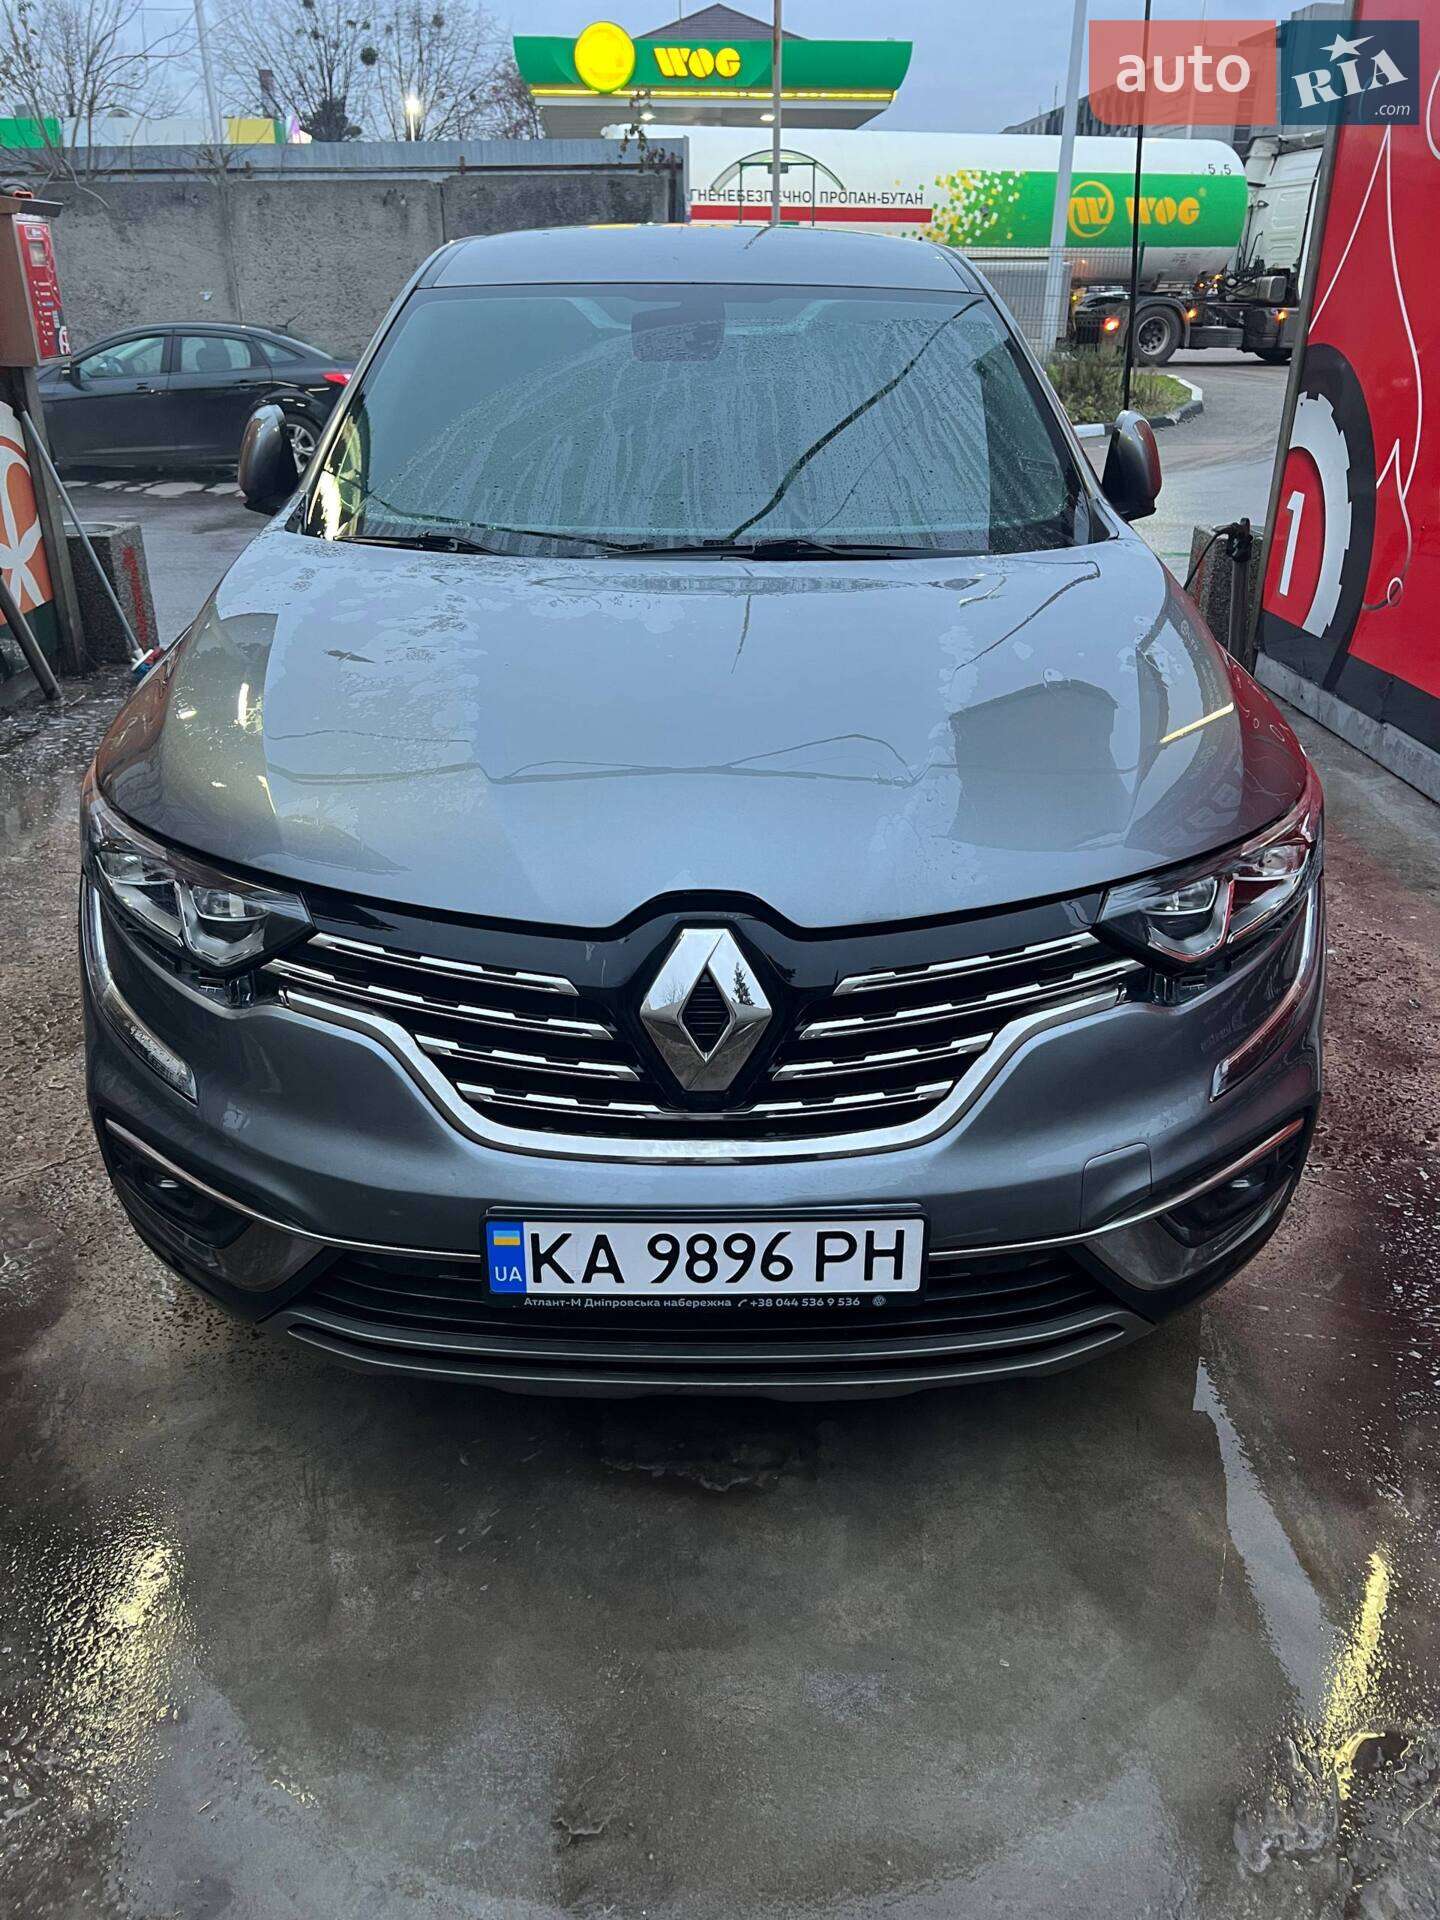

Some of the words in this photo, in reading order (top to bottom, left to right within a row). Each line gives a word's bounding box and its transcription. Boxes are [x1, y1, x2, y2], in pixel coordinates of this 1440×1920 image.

[653, 47, 741, 79] WOG
[820, 190, 924, 205] ПРОПАН-БУТАН
[1125, 196, 1201, 226] WOG
[1279, 490, 1305, 597] 1
[494, 1265, 523, 1282] UA
[647, 1230, 794, 1284] 9896
[524, 1297, 582, 1307] Атлант-М
[584, 1298, 661, 1309] Дніпровська
[663, 1299, 732, 1309] набережна
[750, 1298, 773, 1307] +38
[775, 1298, 799, 1307] 044
[801, 1297, 824, 1307] 536
[827, 1297, 835, 1307] 9
[837, 1297, 861, 1307] 536
